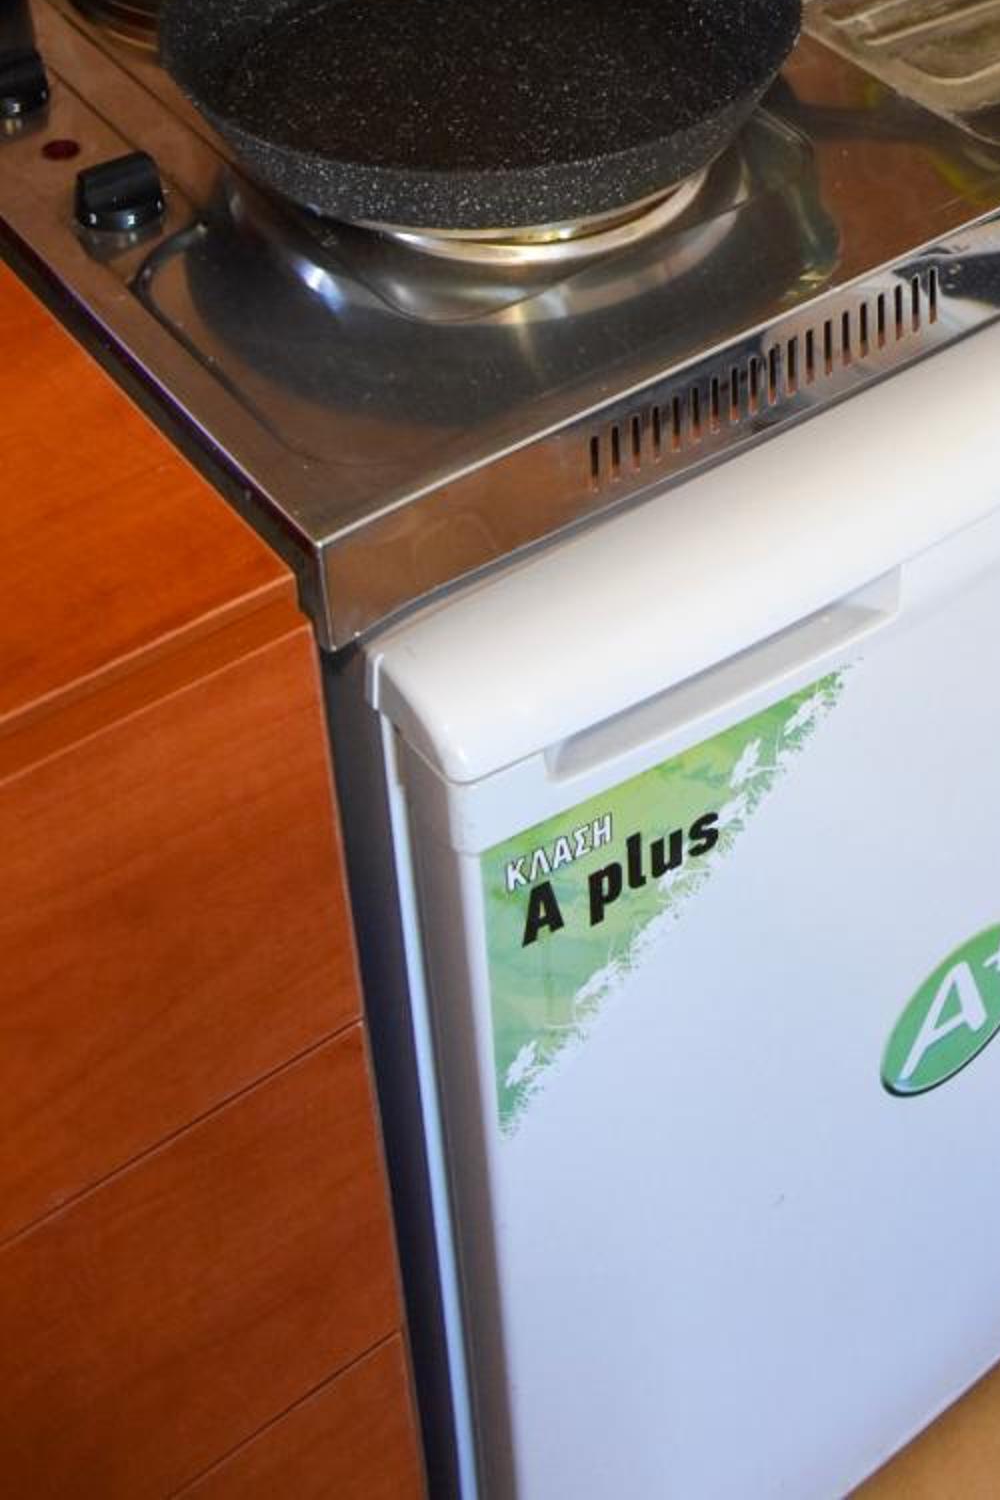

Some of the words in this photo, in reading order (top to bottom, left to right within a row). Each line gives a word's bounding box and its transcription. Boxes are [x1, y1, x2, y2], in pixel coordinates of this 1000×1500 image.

[505, 812, 613, 893] ΚΛΑΣΗ
[522, 881, 564, 948] A
[588, 812, 720, 927] plus
